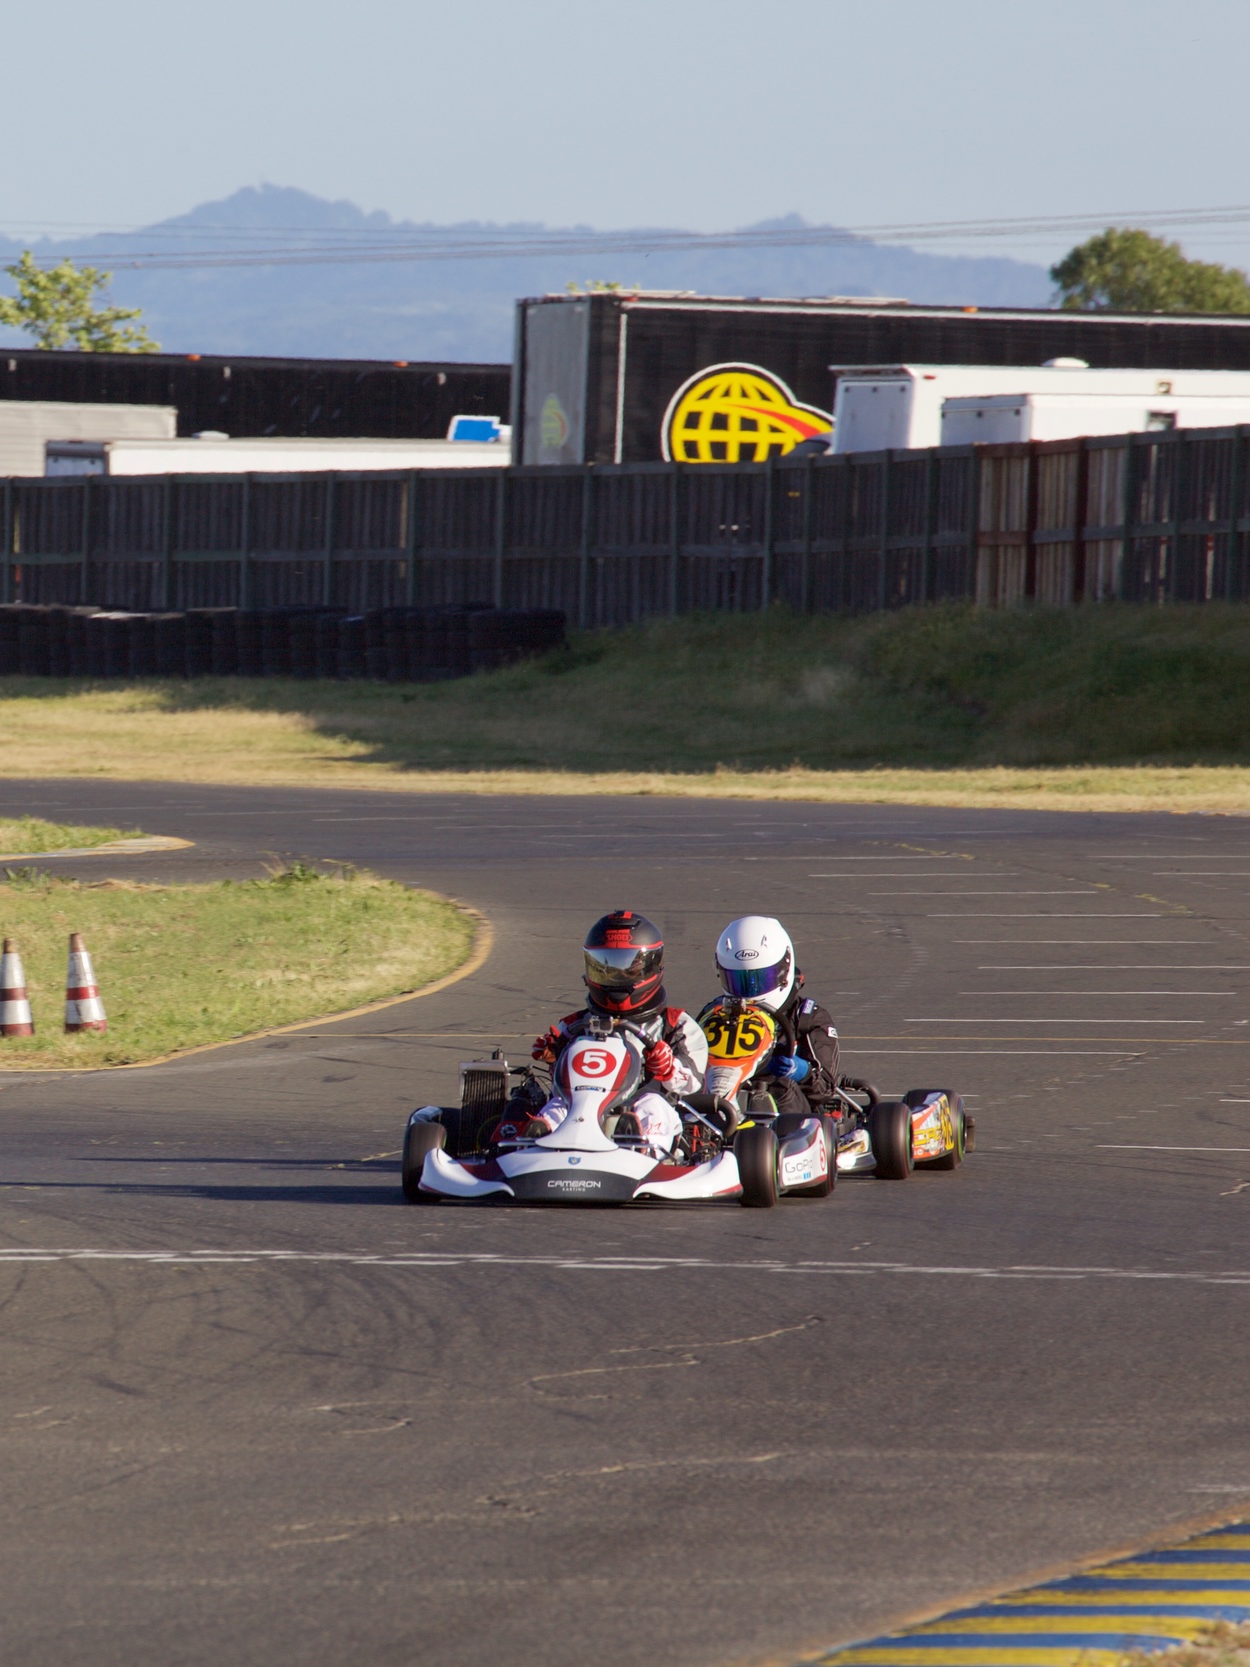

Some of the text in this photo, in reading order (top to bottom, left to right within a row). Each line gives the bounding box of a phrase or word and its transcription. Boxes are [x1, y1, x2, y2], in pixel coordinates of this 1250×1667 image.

[738, 950, 756, 958] Arai
[704, 1016, 762, 1055] 315
[581, 1051, 607, 1074] 5
[547, 1180, 601, 1188] CAMERON
